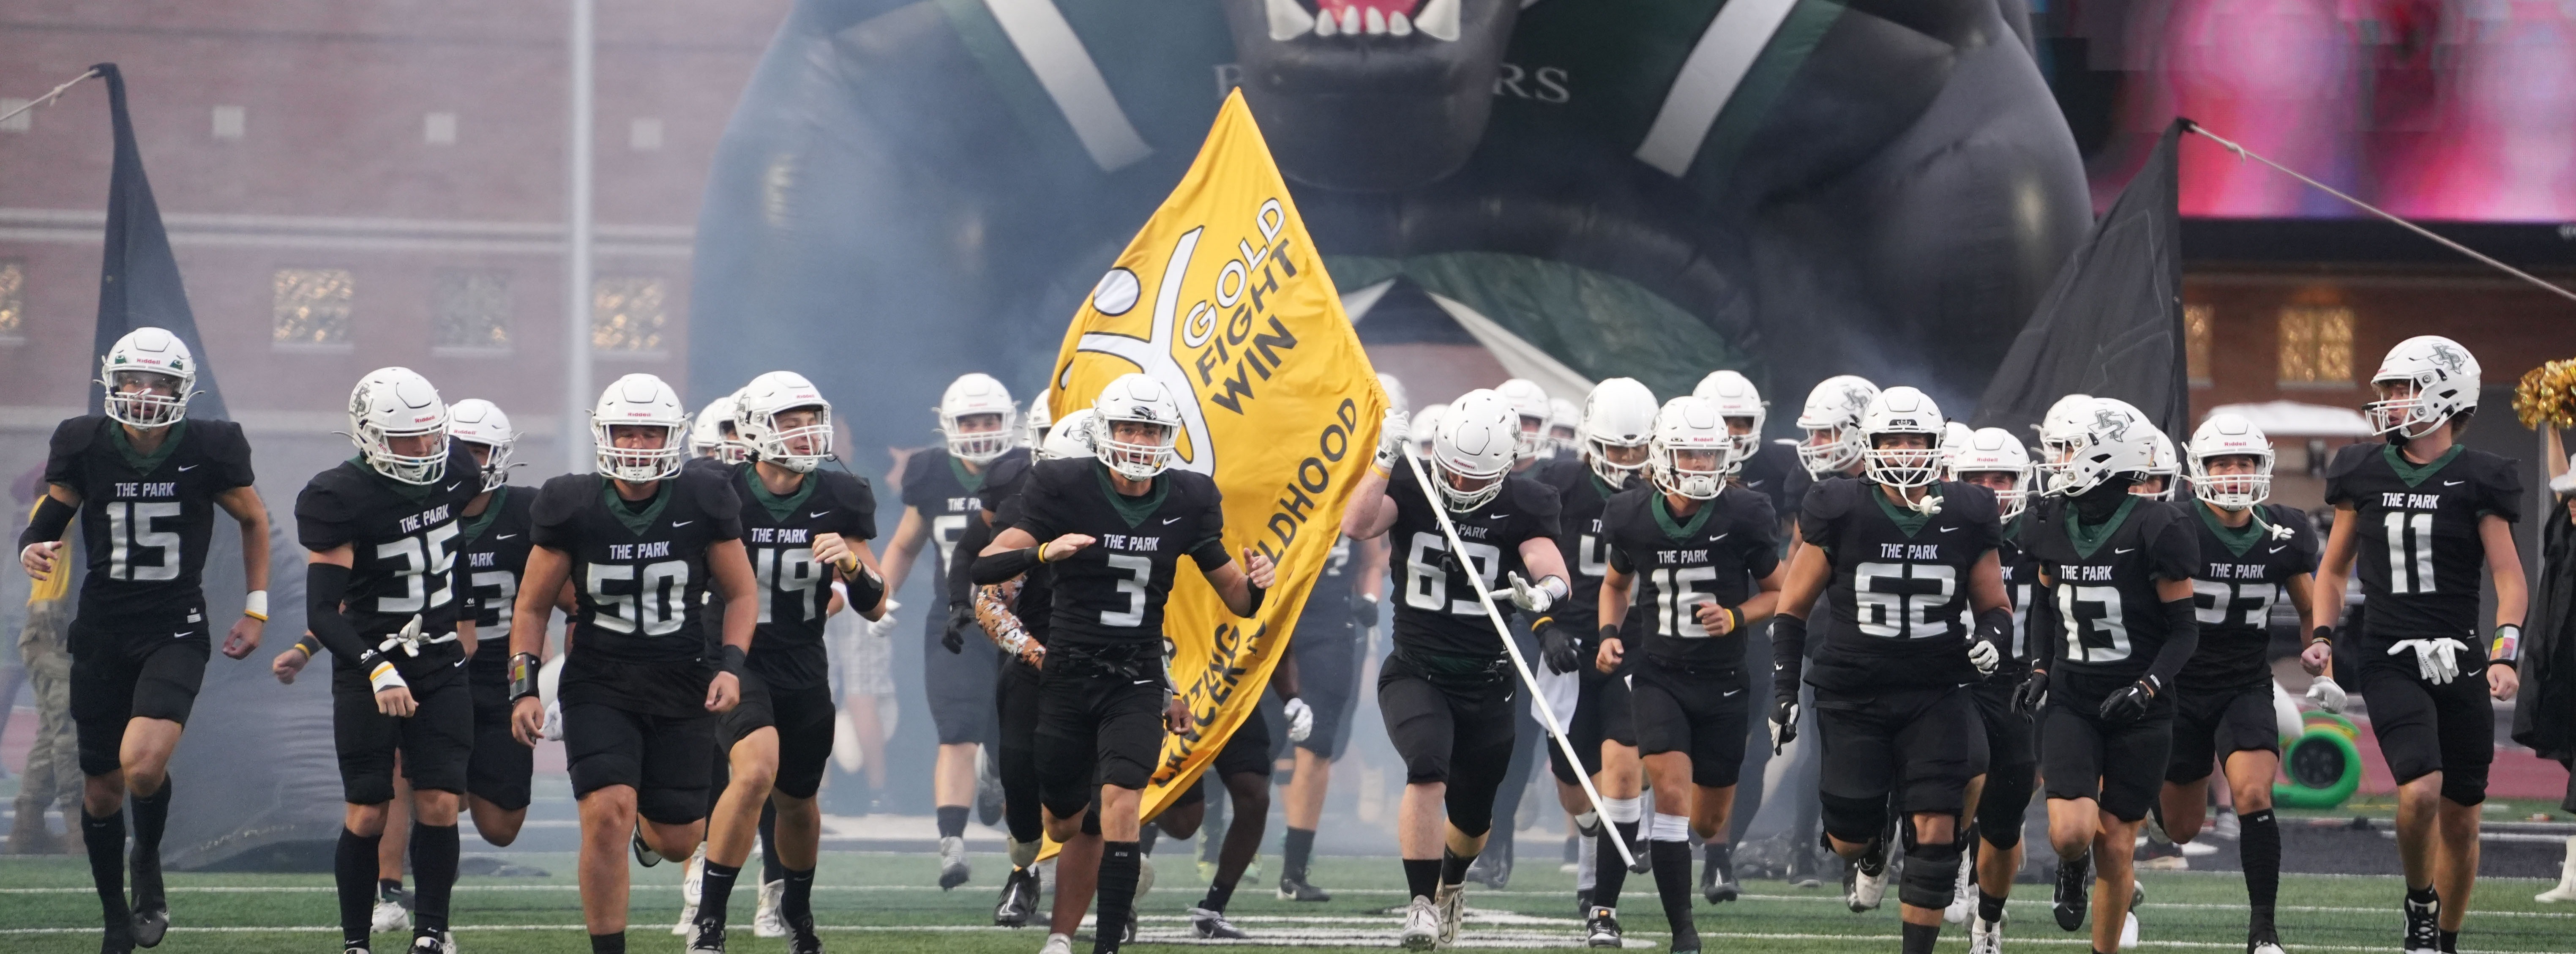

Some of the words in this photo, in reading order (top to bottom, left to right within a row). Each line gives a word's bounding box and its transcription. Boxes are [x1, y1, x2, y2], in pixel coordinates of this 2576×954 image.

[1182, 197, 1285, 348] GOLD
[1196, 238, 1298, 387] FIGHT
[1211, 315, 1298, 416] WIN
[115, 483, 139, 497] THE
[142, 482, 175, 497] PARK
[948, 498, 966, 511] THE
[2382, 492, 2406, 507] THE
[2407, 494, 2440, 509] PARK
[399, 514, 421, 533] THE
[423, 503, 449, 526] PARK
[1458, 524, 1488, 539] PARK
[106, 502, 181, 581] 15
[609, 544, 633, 560] THE
[637, 541, 669, 558] PARK
[752, 528, 774, 542] THE
[777, 529, 808, 543] PARK
[1104, 534, 1127, 550] THE
[1128, 536, 1160, 551] PARK
[377, 519, 459, 612] 35
[469, 552, 494, 567] ARK
[1657, 550, 1677, 564] THE
[1681, 550, 1708, 564] PARK
[1880, 543, 1904, 558] THE
[1907, 544, 1938, 559] PARK
[2384, 511, 2437, 593] 11
[1405, 531, 1500, 616] 63
[2060, 565, 2079, 580] THE
[2082, 566, 2112, 580] PARK
[2210, 563, 2232, 577] THE
[2235, 564, 2265, 579] PARK
[587, 560, 689, 636] 50
[1100, 554, 1152, 627] 3
[1651, 566, 1717, 637] 16
[1855, 562, 1957, 639] 62
[2057, 583, 2132, 662] 13
